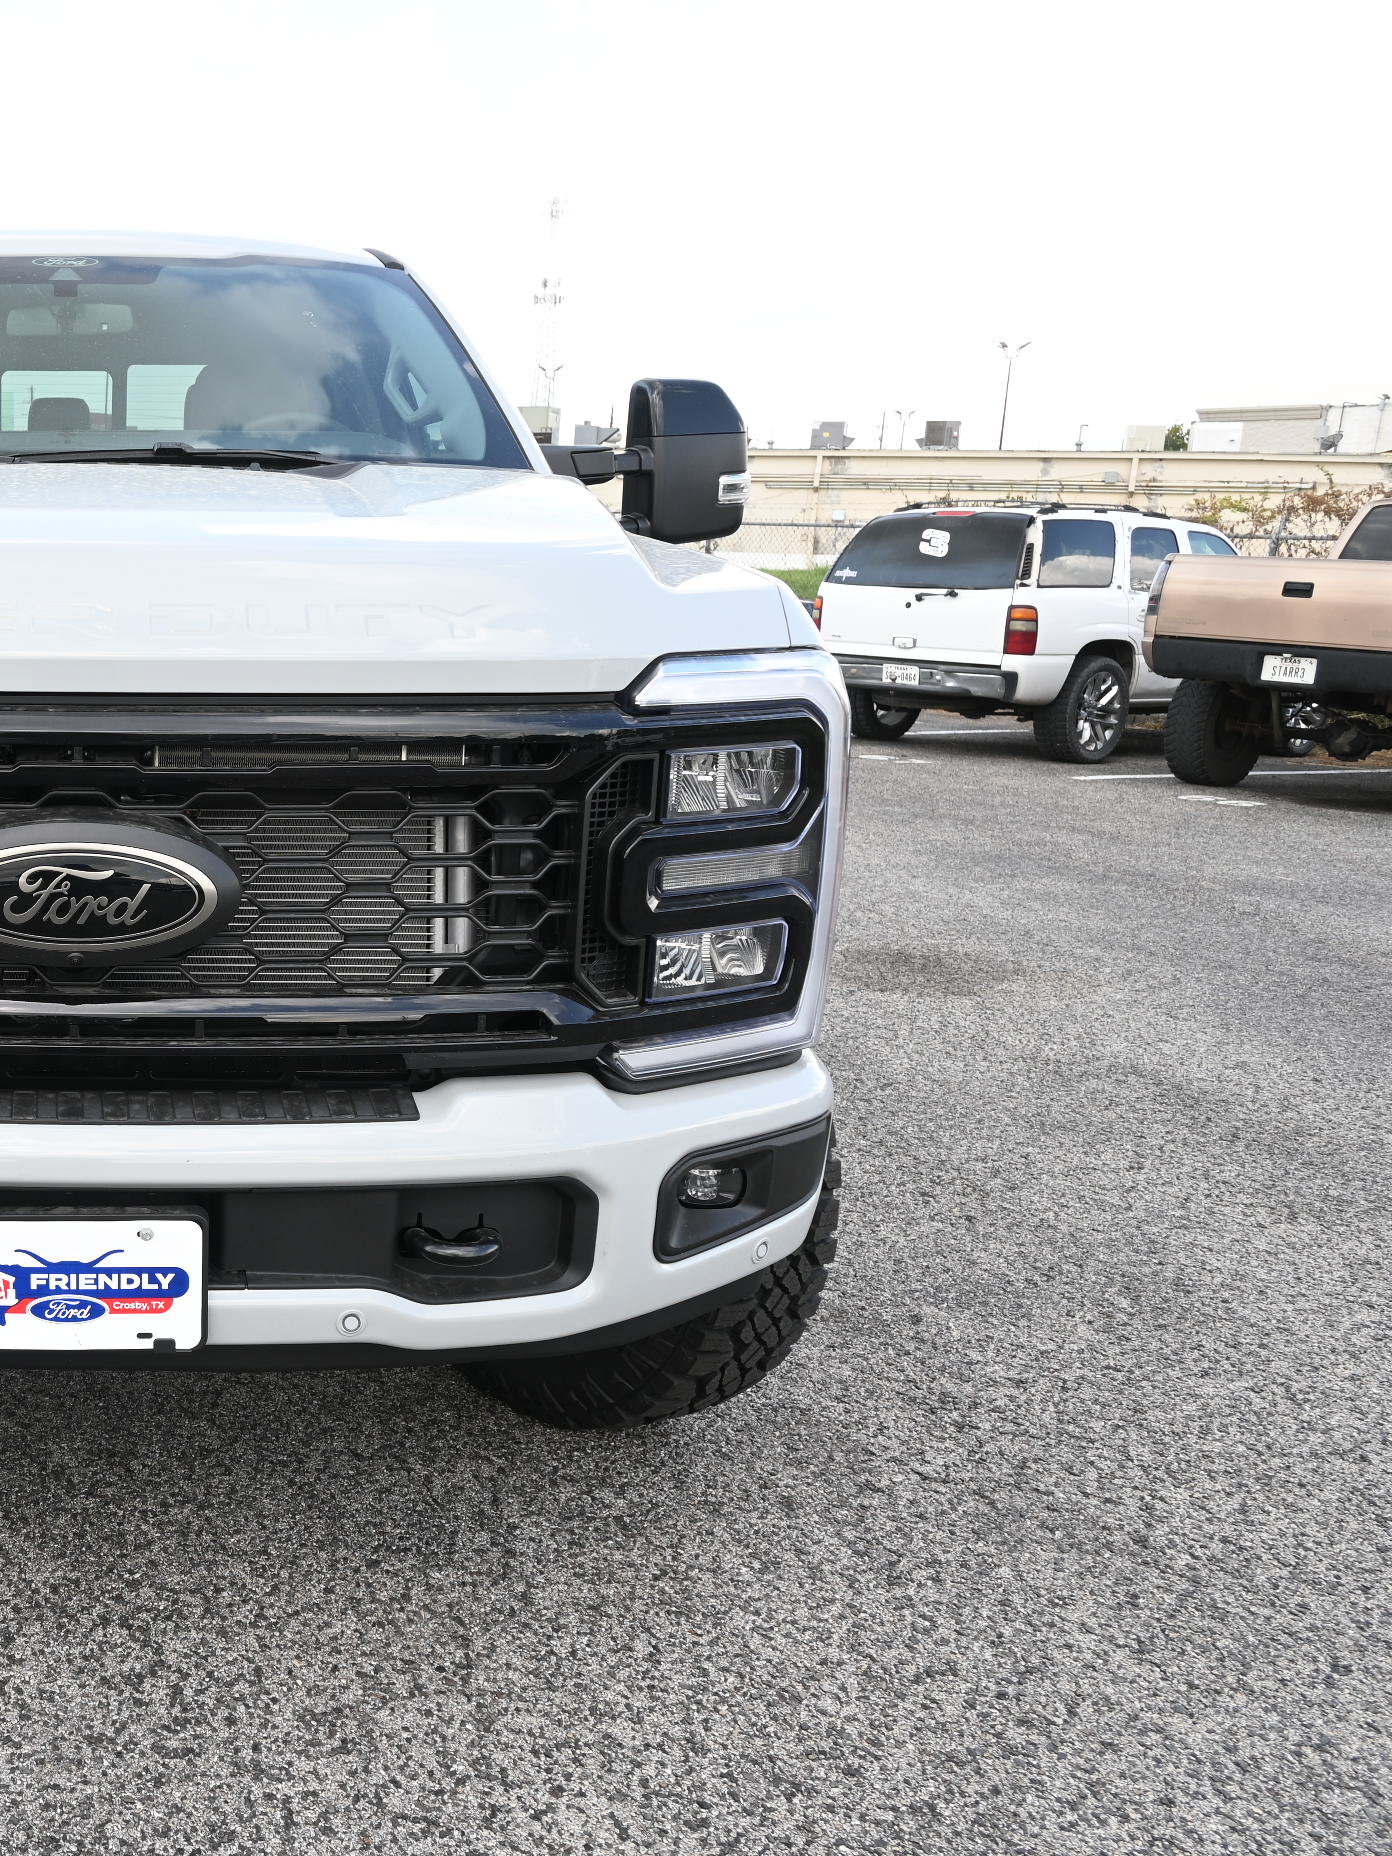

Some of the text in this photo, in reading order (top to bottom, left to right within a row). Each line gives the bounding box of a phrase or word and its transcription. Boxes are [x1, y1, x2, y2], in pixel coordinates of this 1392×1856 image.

[44, 258, 87, 266] Ford
[919, 528, 951, 558] 3
[144, 600, 495, 640] DUTY
[1280, 656, 1301, 665] TEXAS
[1271, 665, 1306, 679] STARR3
[2, 865, 152, 926] Ford
[29, 1272, 176, 1291] FRIENDLY
[44, 1299, 91, 1320] Ford
[112, 1301, 166, 1311] Crosby, TX
